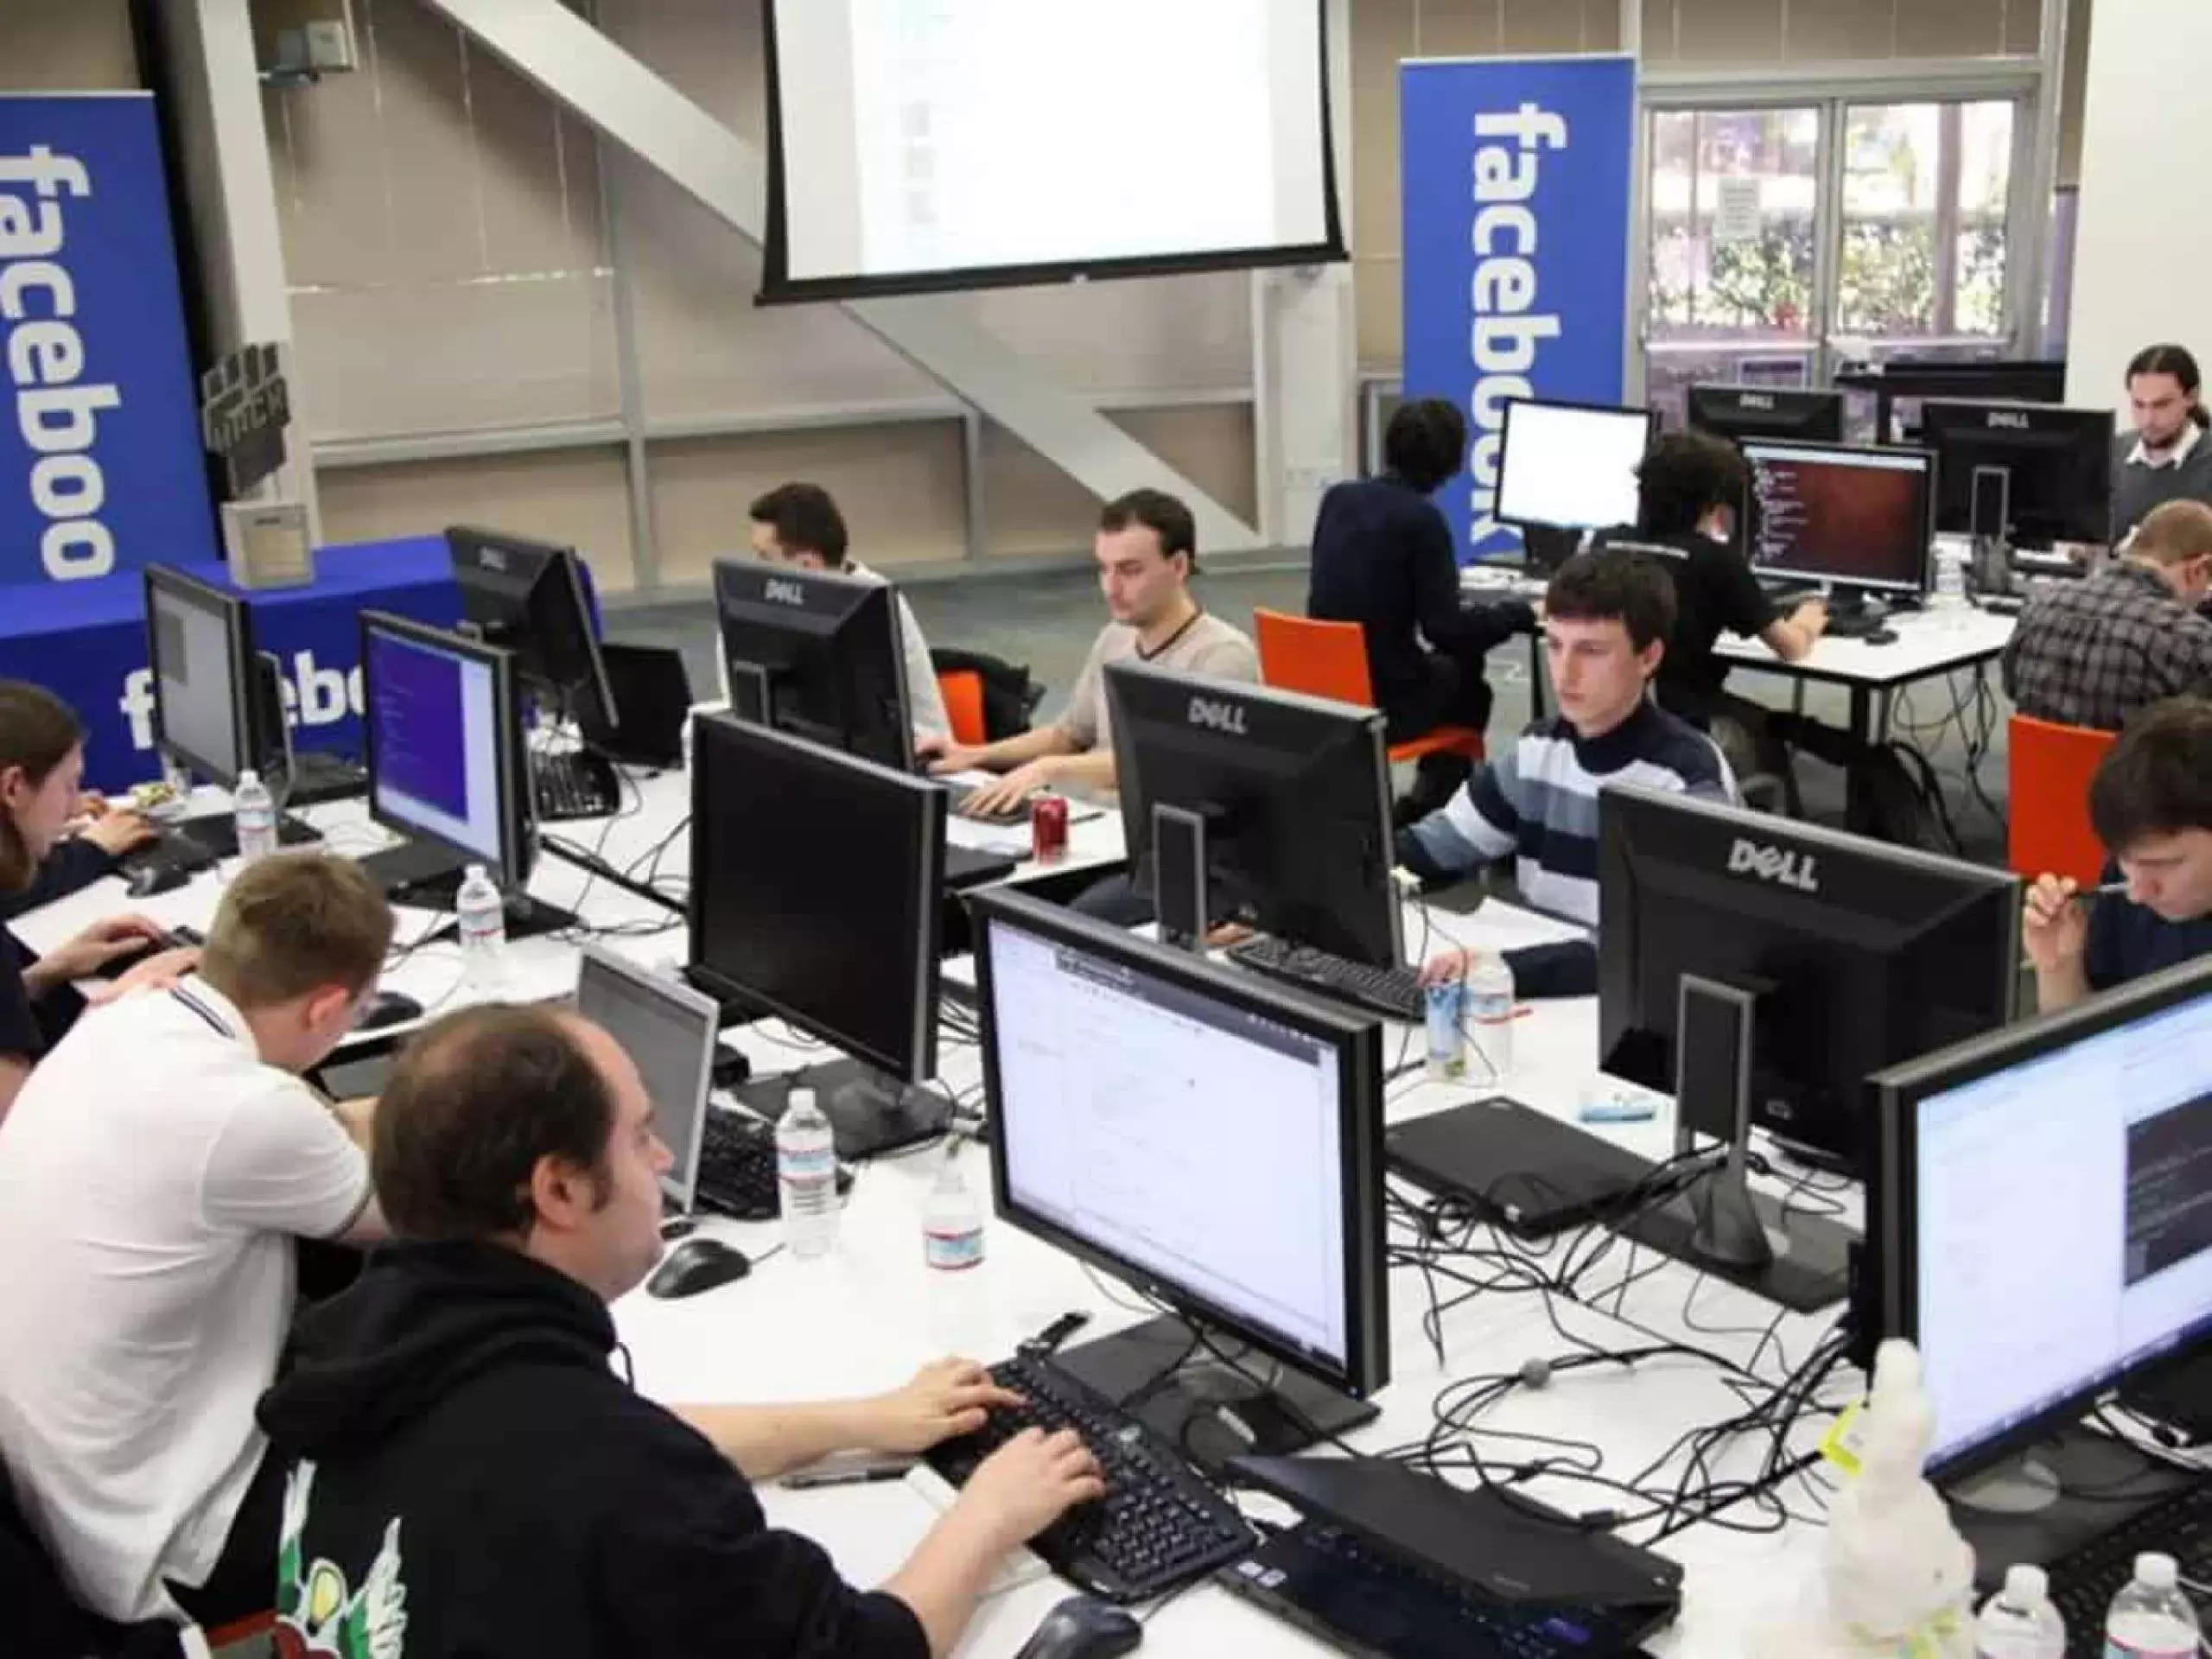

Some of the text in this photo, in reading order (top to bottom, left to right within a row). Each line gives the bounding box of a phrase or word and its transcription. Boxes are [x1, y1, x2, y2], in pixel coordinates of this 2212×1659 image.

[0, 144, 121, 581] faceboo
[1188, 696, 1246, 734] DELL
[1727, 839, 1818, 892] DELL
